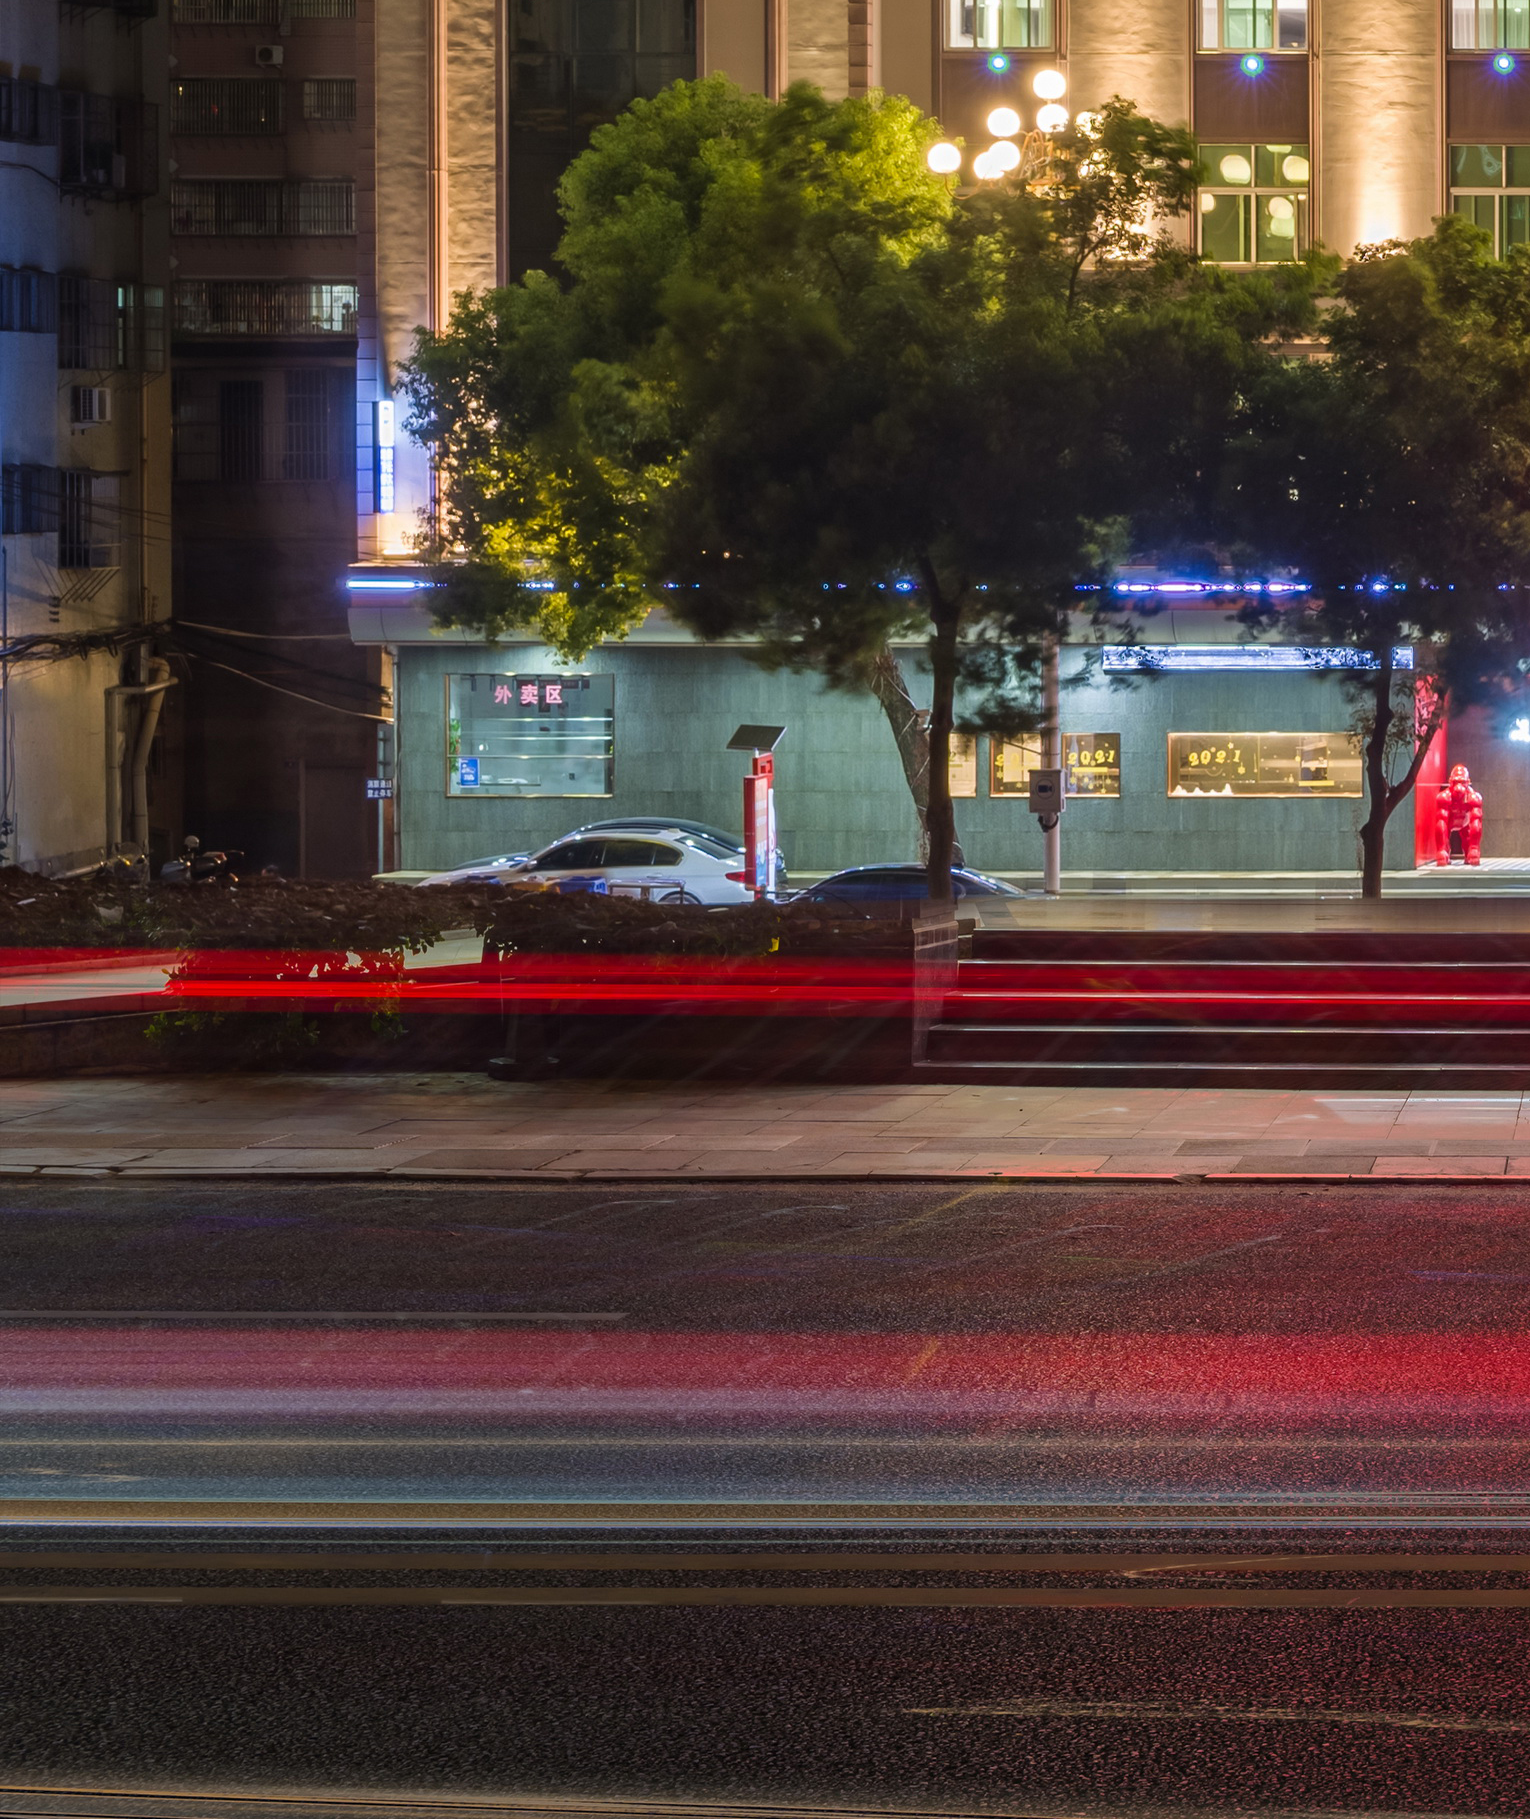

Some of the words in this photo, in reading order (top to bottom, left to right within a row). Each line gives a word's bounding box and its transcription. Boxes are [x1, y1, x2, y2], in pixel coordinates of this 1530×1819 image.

[493, 684, 563, 705] 外卖区
[1067, 749, 1116, 766] 2021
[1188, 748, 1242, 768] 2021
